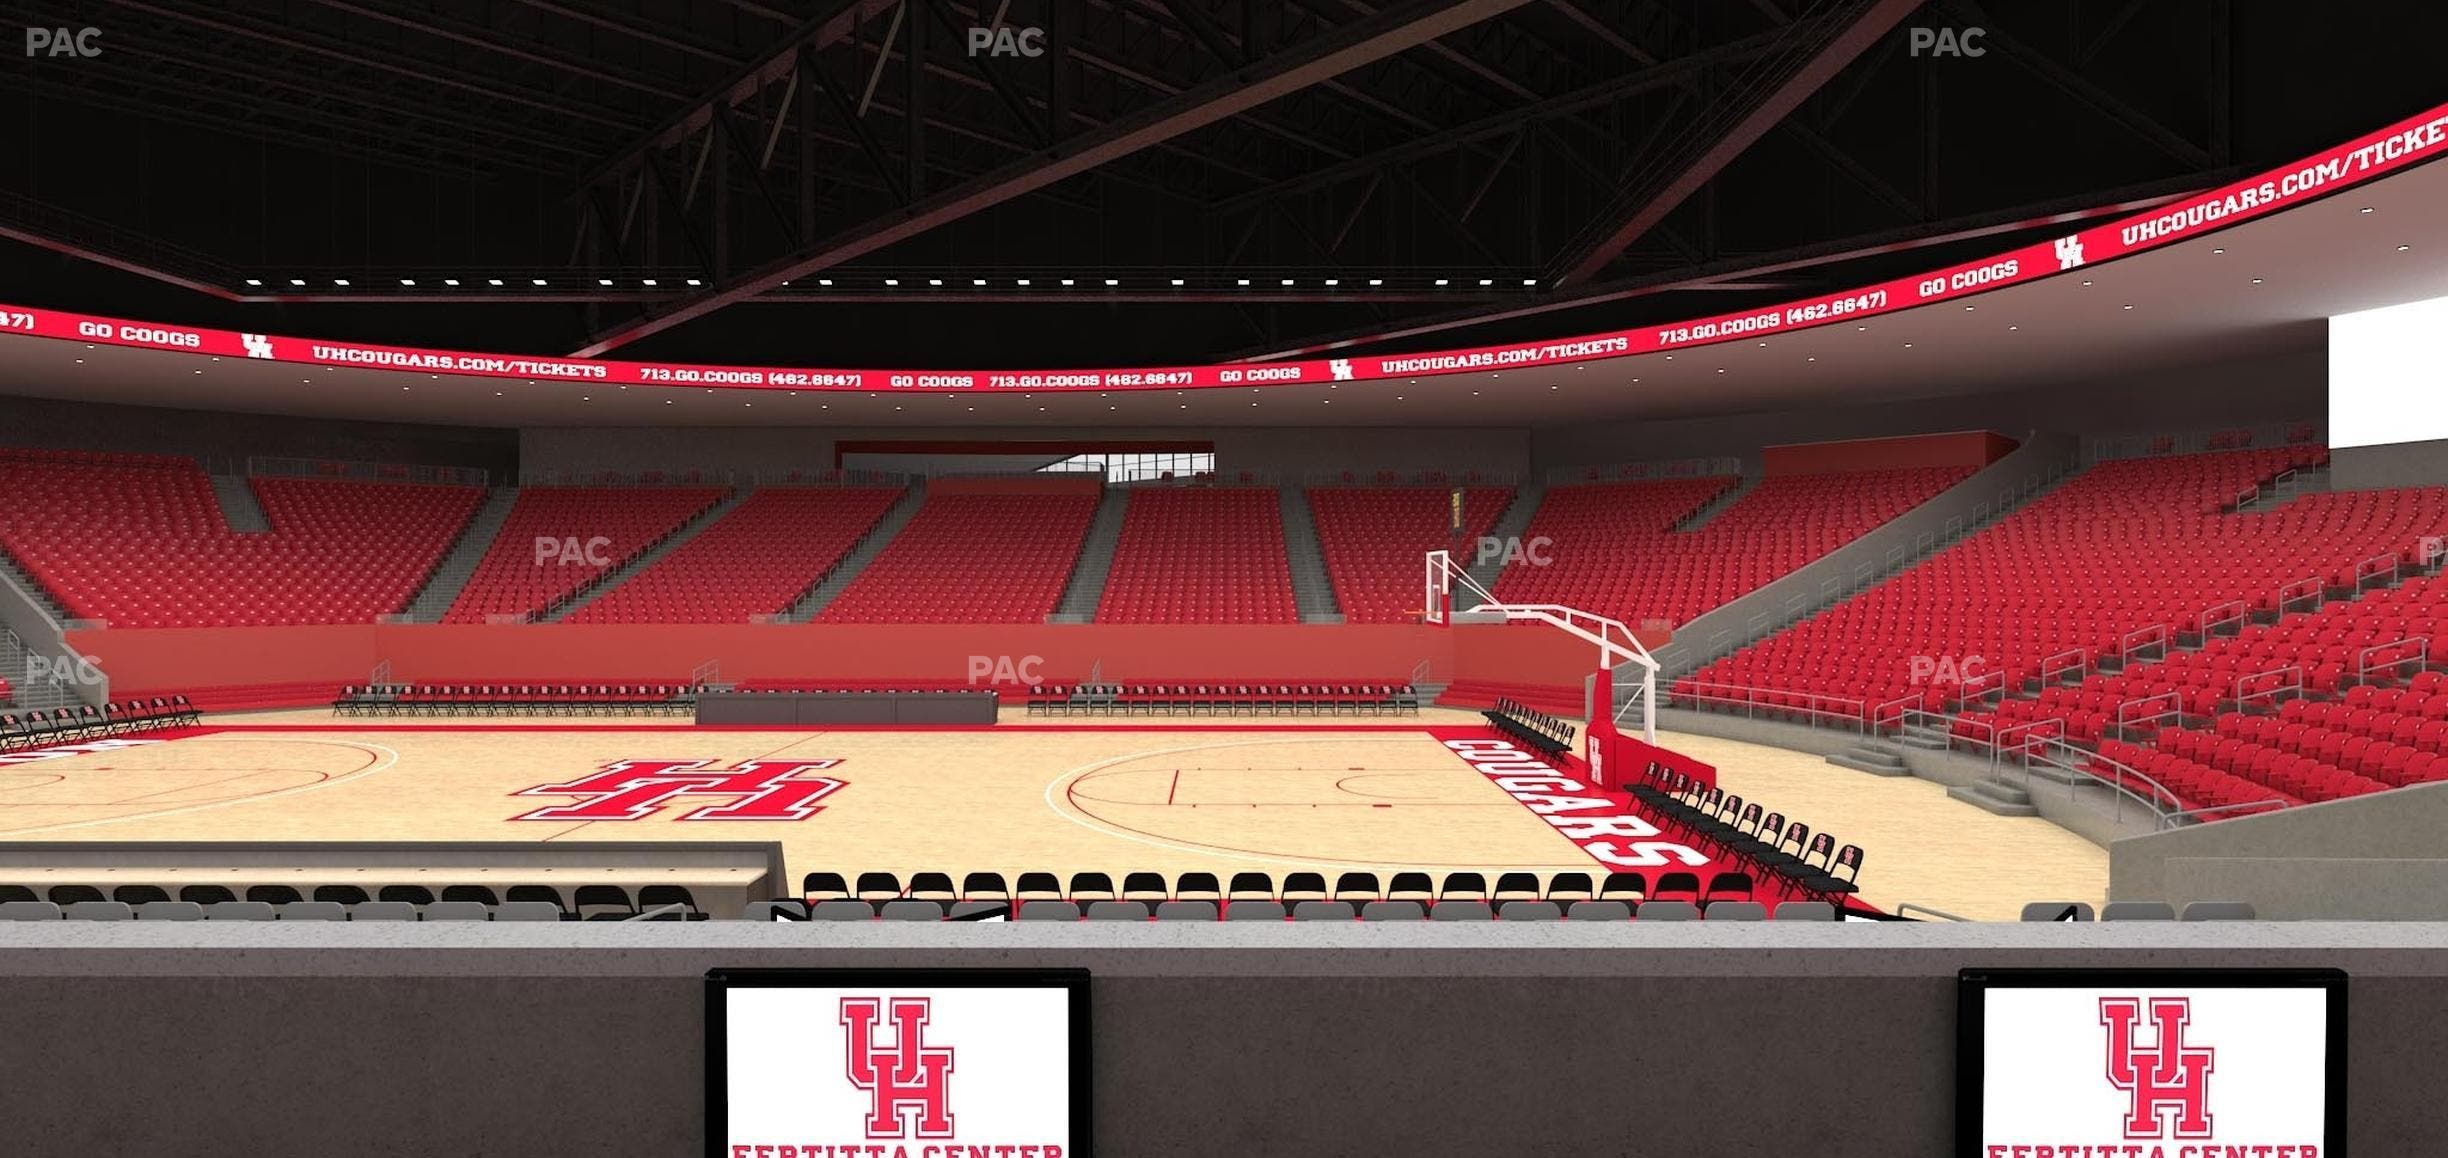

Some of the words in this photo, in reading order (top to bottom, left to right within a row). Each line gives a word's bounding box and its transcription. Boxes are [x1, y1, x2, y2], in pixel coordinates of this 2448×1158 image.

[2121, 115, 2448, 246] UHCOUGARS.COM/TICKE
[1919, 277, 1946, 298] GO
[1951, 259, 2019, 290] COOGS
[79, 321, 113, 338] GO
[120, 326, 201, 348] COOGS
[1659, 312, 1781, 346] 713.GO.COOGS
[312, 345, 607, 378] UHCOUGARS.COM/TICKETS
[1381, 337, 1628, 376] UHCOUGARS.COM/TICKETS
[640, 368, 763, 384] 713.GO.COOGS
[890, 375, 914, 388] GO
[917, 375, 974, 388] COOGS
[990, 375, 1101, 388] 713.GO.COOGS
[1220, 370, 1243, 383] GO
[1246, 367, 1301, 382] COOGS
[1443, 739, 1712, 867] COUGARS
[839, 997, 954, 1139] UH
[2099, 997, 2214, 1139] UH
